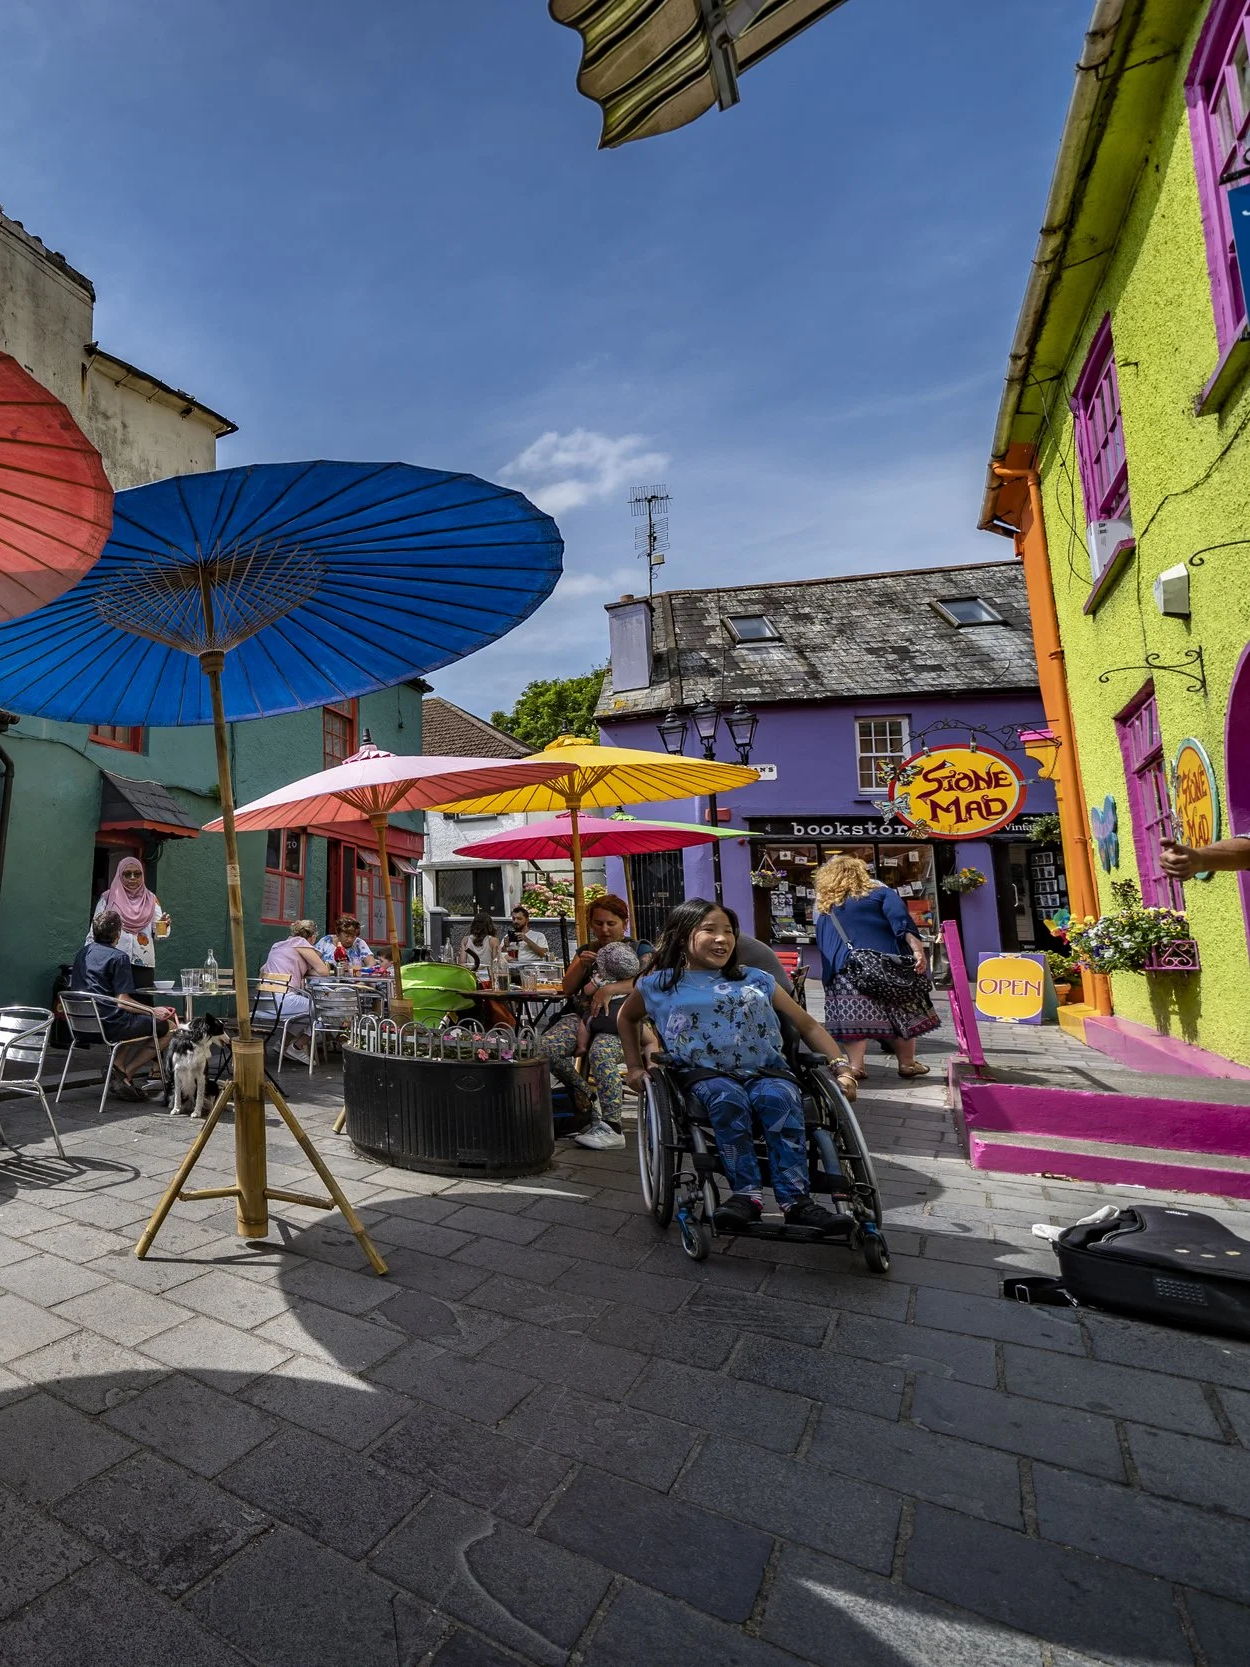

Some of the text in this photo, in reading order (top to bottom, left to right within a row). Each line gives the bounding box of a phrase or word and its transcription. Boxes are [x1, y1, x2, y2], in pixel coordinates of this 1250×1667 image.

[916, 760, 1013, 805] STONE
[1181, 764, 1208, 820] STONE
[929, 794, 1008, 825] MAD
[791, 822, 909, 836] bookstor
[1004, 822, 1034, 831] Vinta
[978, 978, 1041, 997] OPEN
